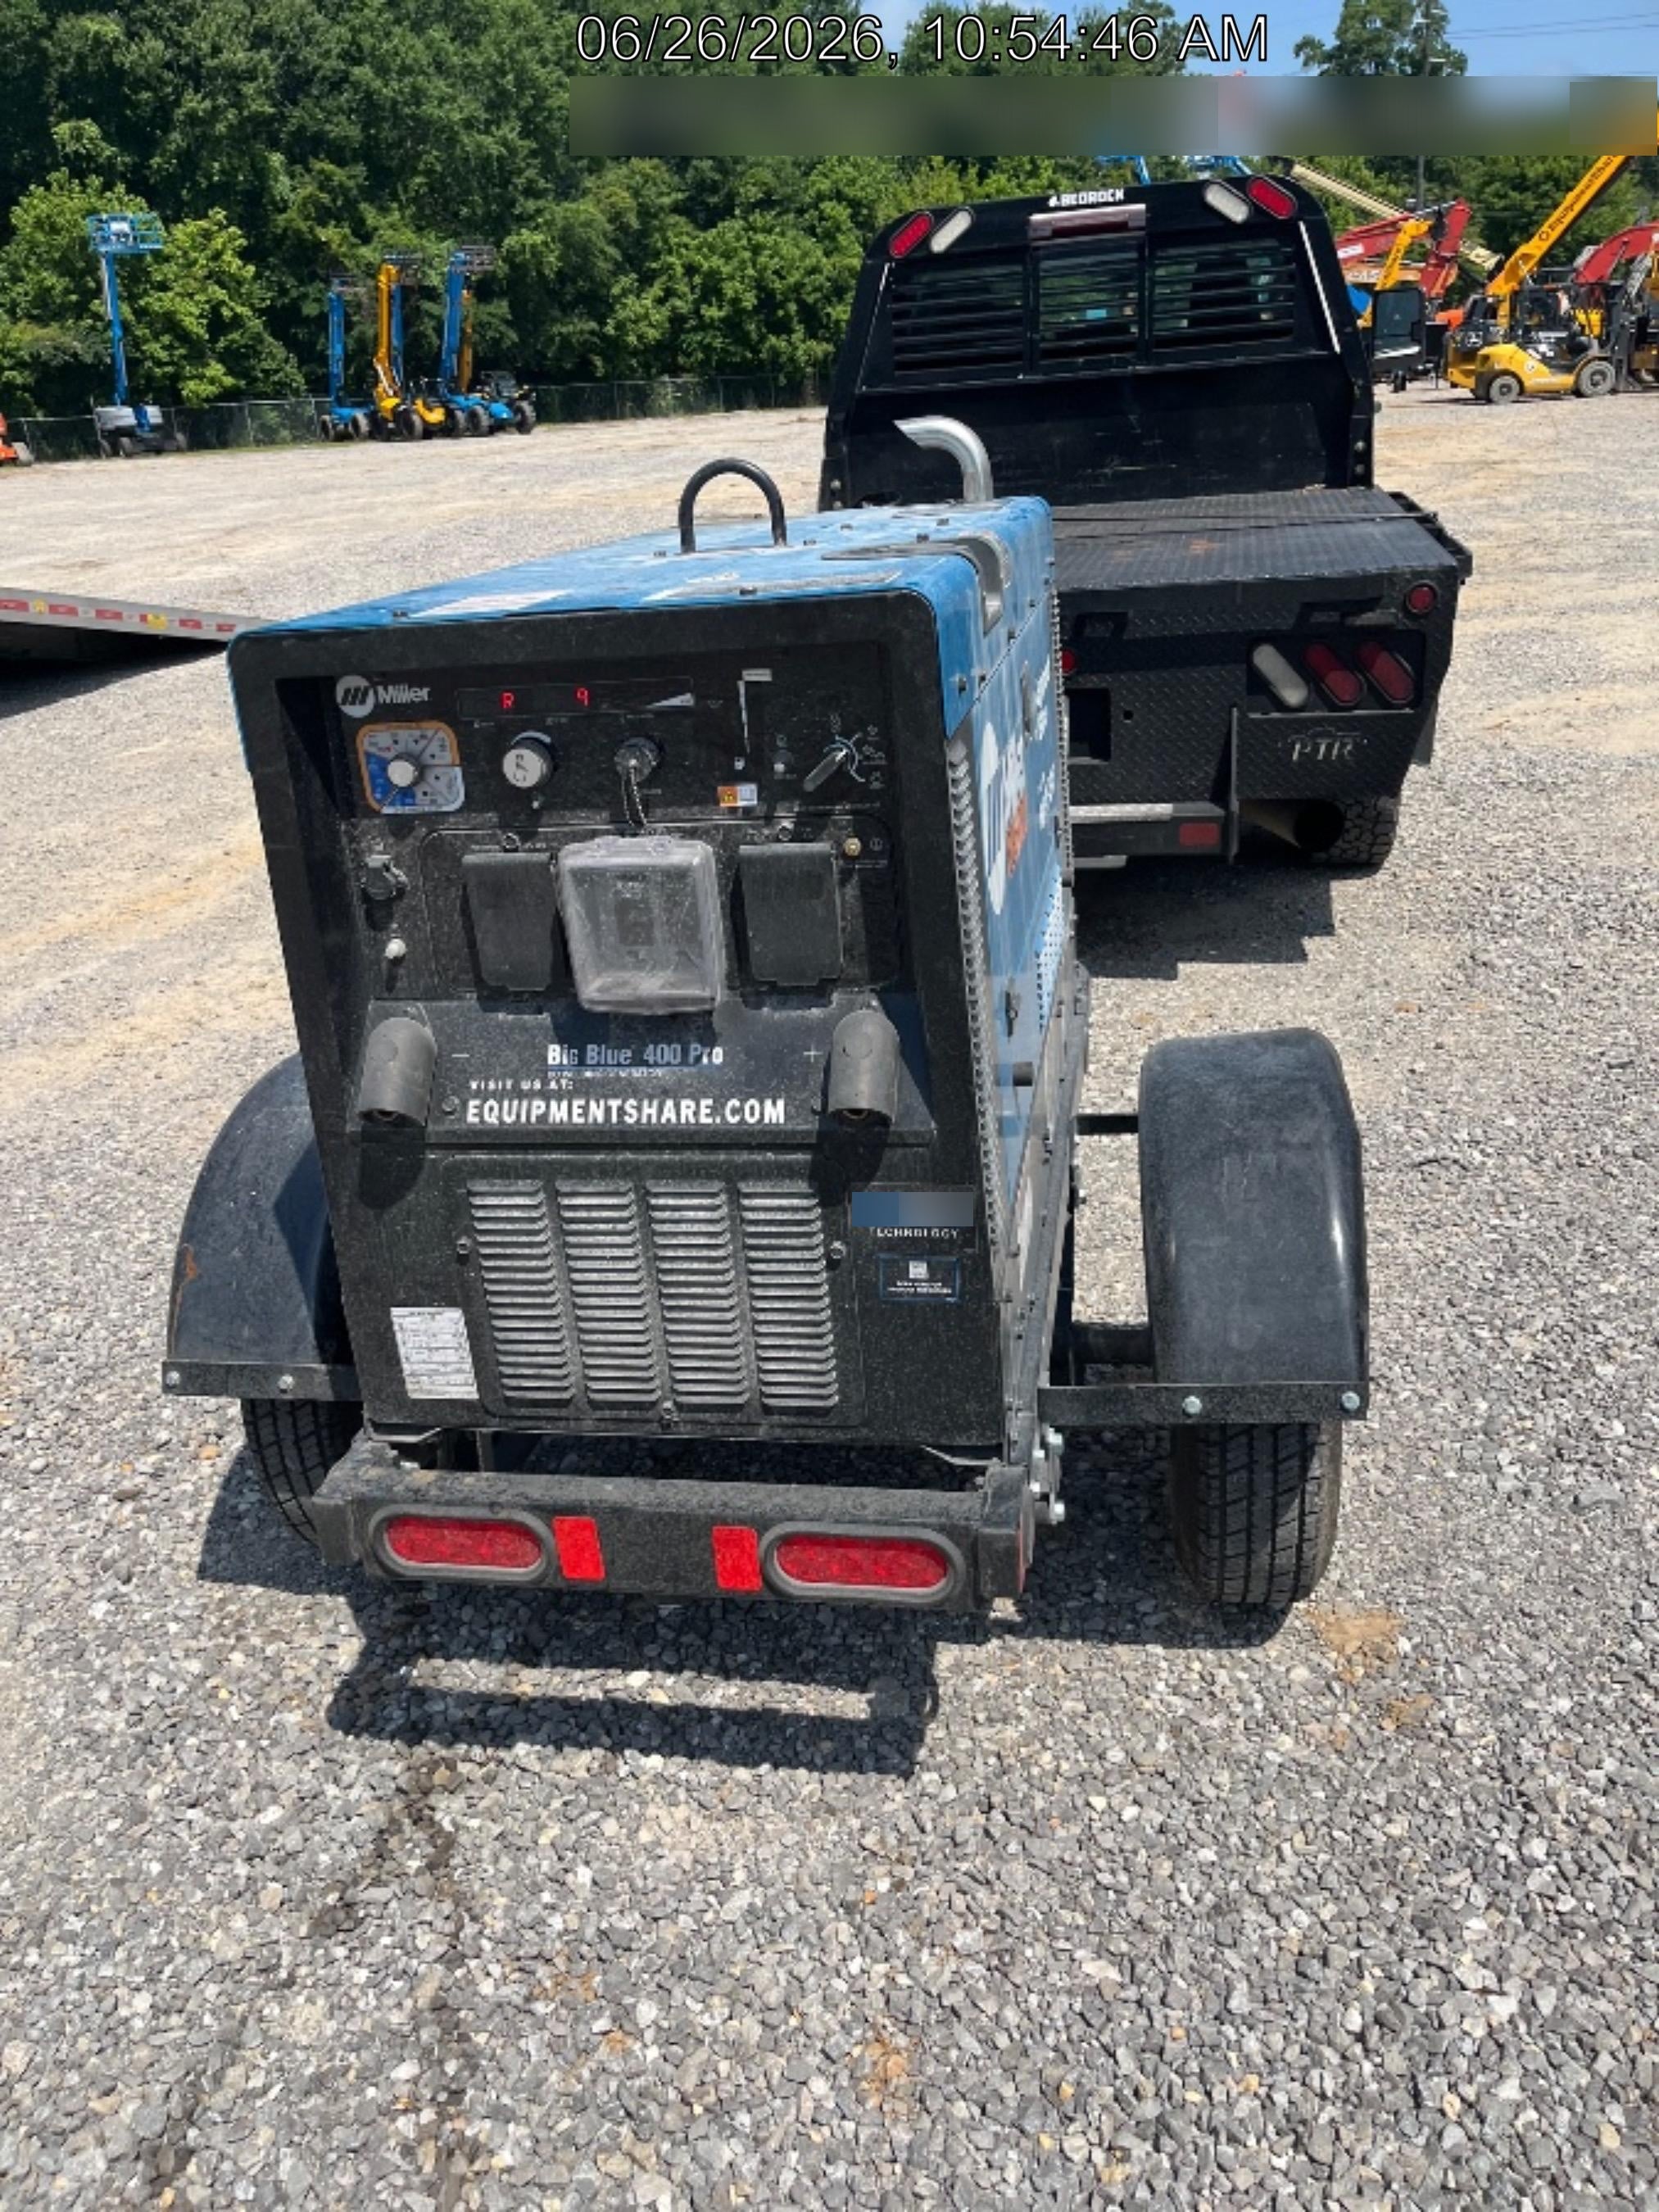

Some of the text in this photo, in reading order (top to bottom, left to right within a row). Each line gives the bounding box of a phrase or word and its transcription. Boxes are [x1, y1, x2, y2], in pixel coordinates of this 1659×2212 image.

[1060, 188, 1125, 208] BEDROCK
[377, 683, 431, 705] Miller
[547, 1044, 724, 1065] Big Blue 400 Pro
[469, 1079, 574, 1090] VISIT US AT:
[466, 1098, 786, 1125] EQUIPMENTSHARE.COM
